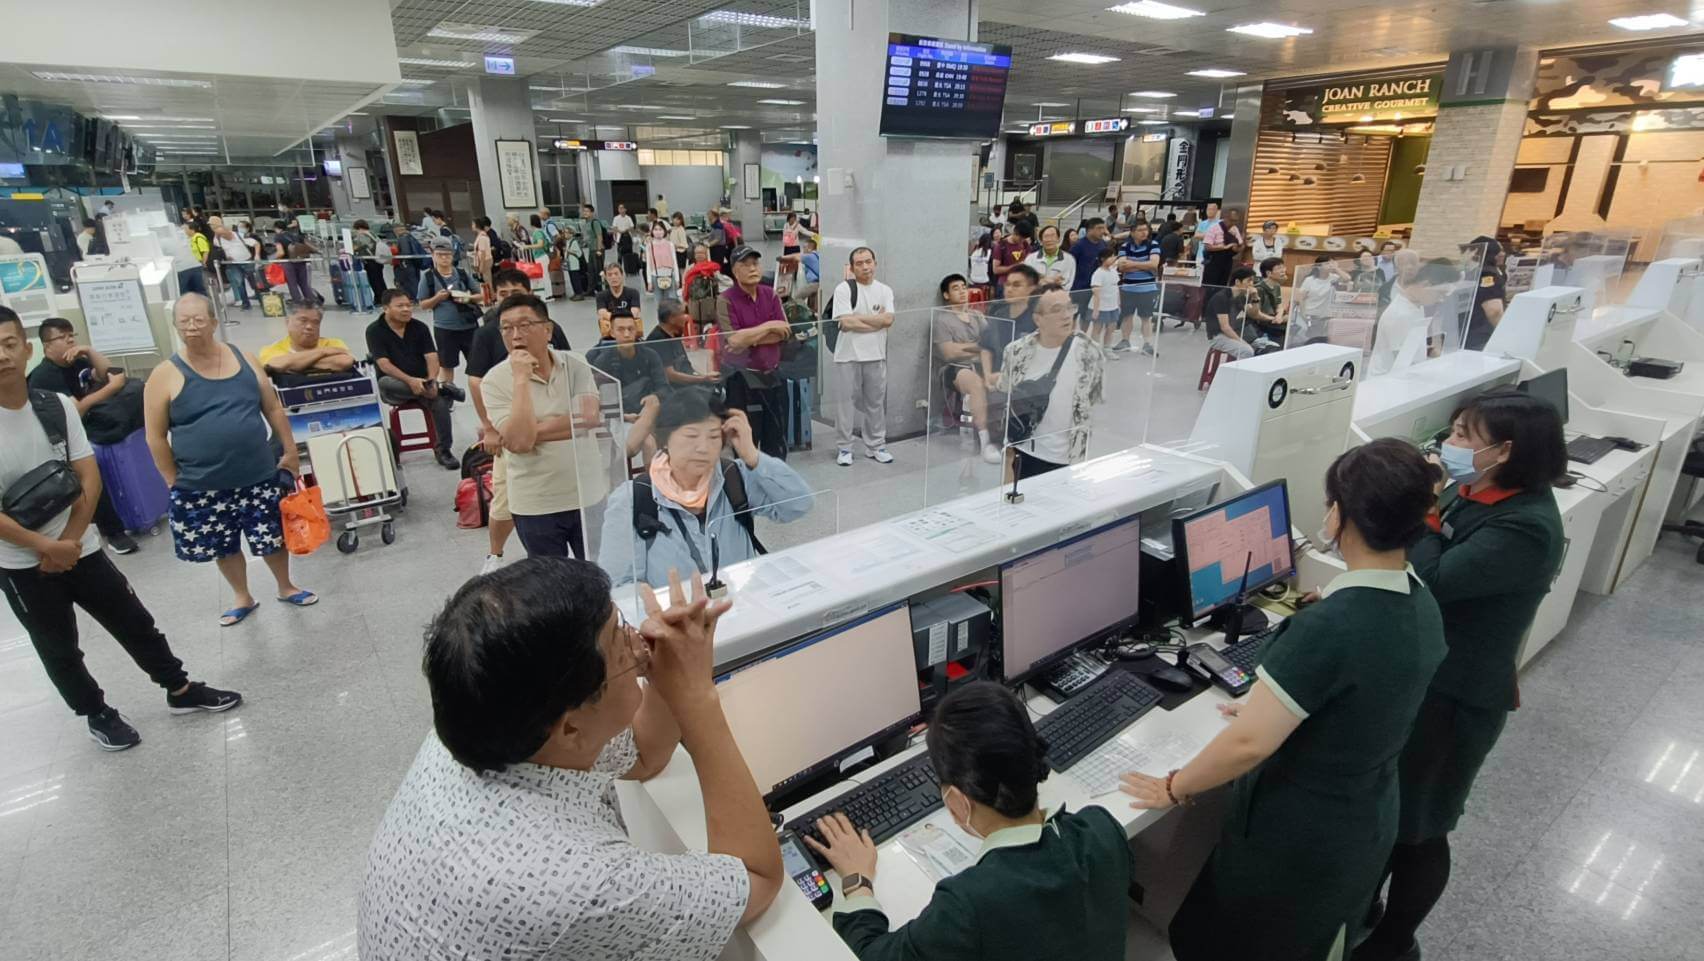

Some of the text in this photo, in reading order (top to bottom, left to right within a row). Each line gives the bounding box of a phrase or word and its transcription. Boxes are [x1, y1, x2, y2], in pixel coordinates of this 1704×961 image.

[1322, 78, 1432, 104] JOAN RANCH
[1321, 97, 1429, 114] CREATIVE GOURMET
